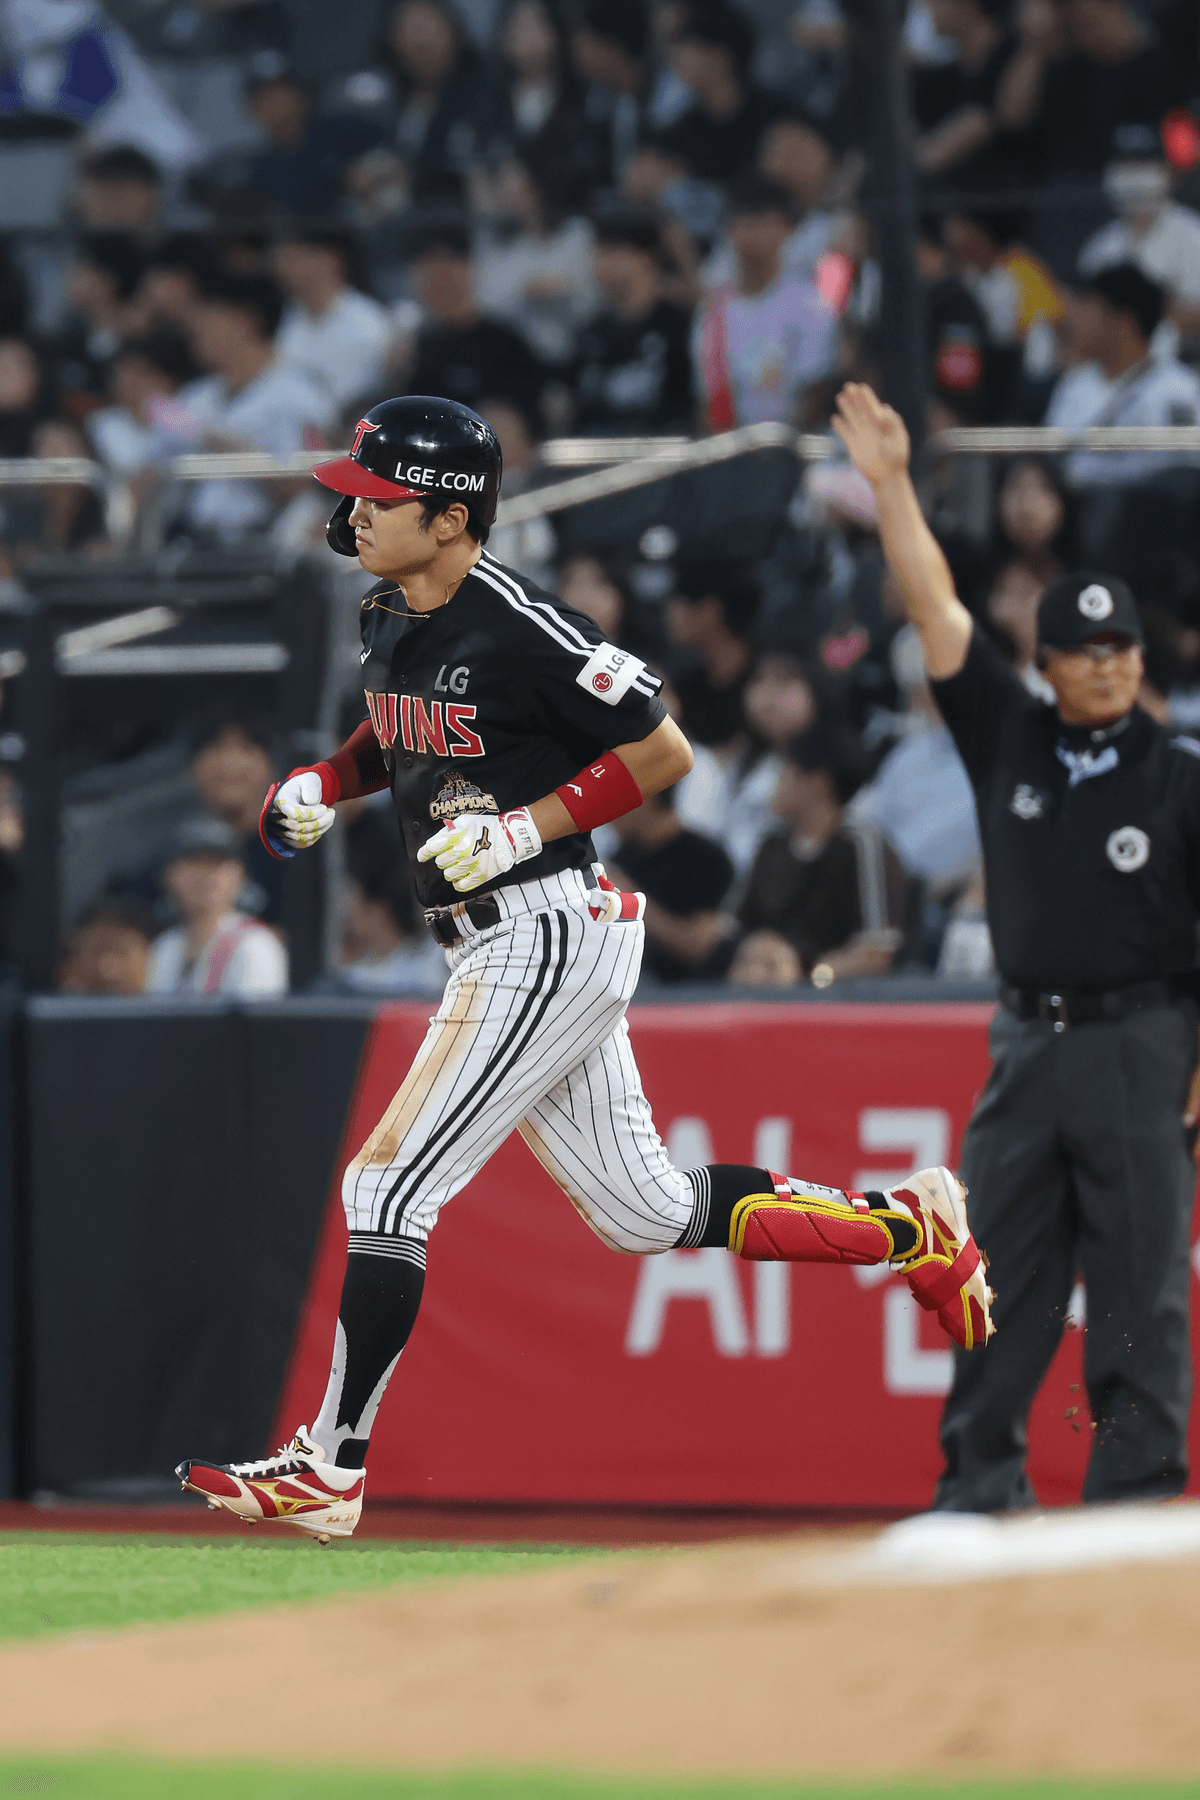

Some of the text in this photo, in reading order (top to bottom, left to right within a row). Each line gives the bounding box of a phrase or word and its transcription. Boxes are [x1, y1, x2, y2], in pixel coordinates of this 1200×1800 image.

[351, 418, 383, 456] T
[394, 461, 486, 492] LGE.COM
[434, 664, 470, 695] LG
[605, 654, 626, 675] LG
[429, 793, 499, 820] CHAMPIONS
